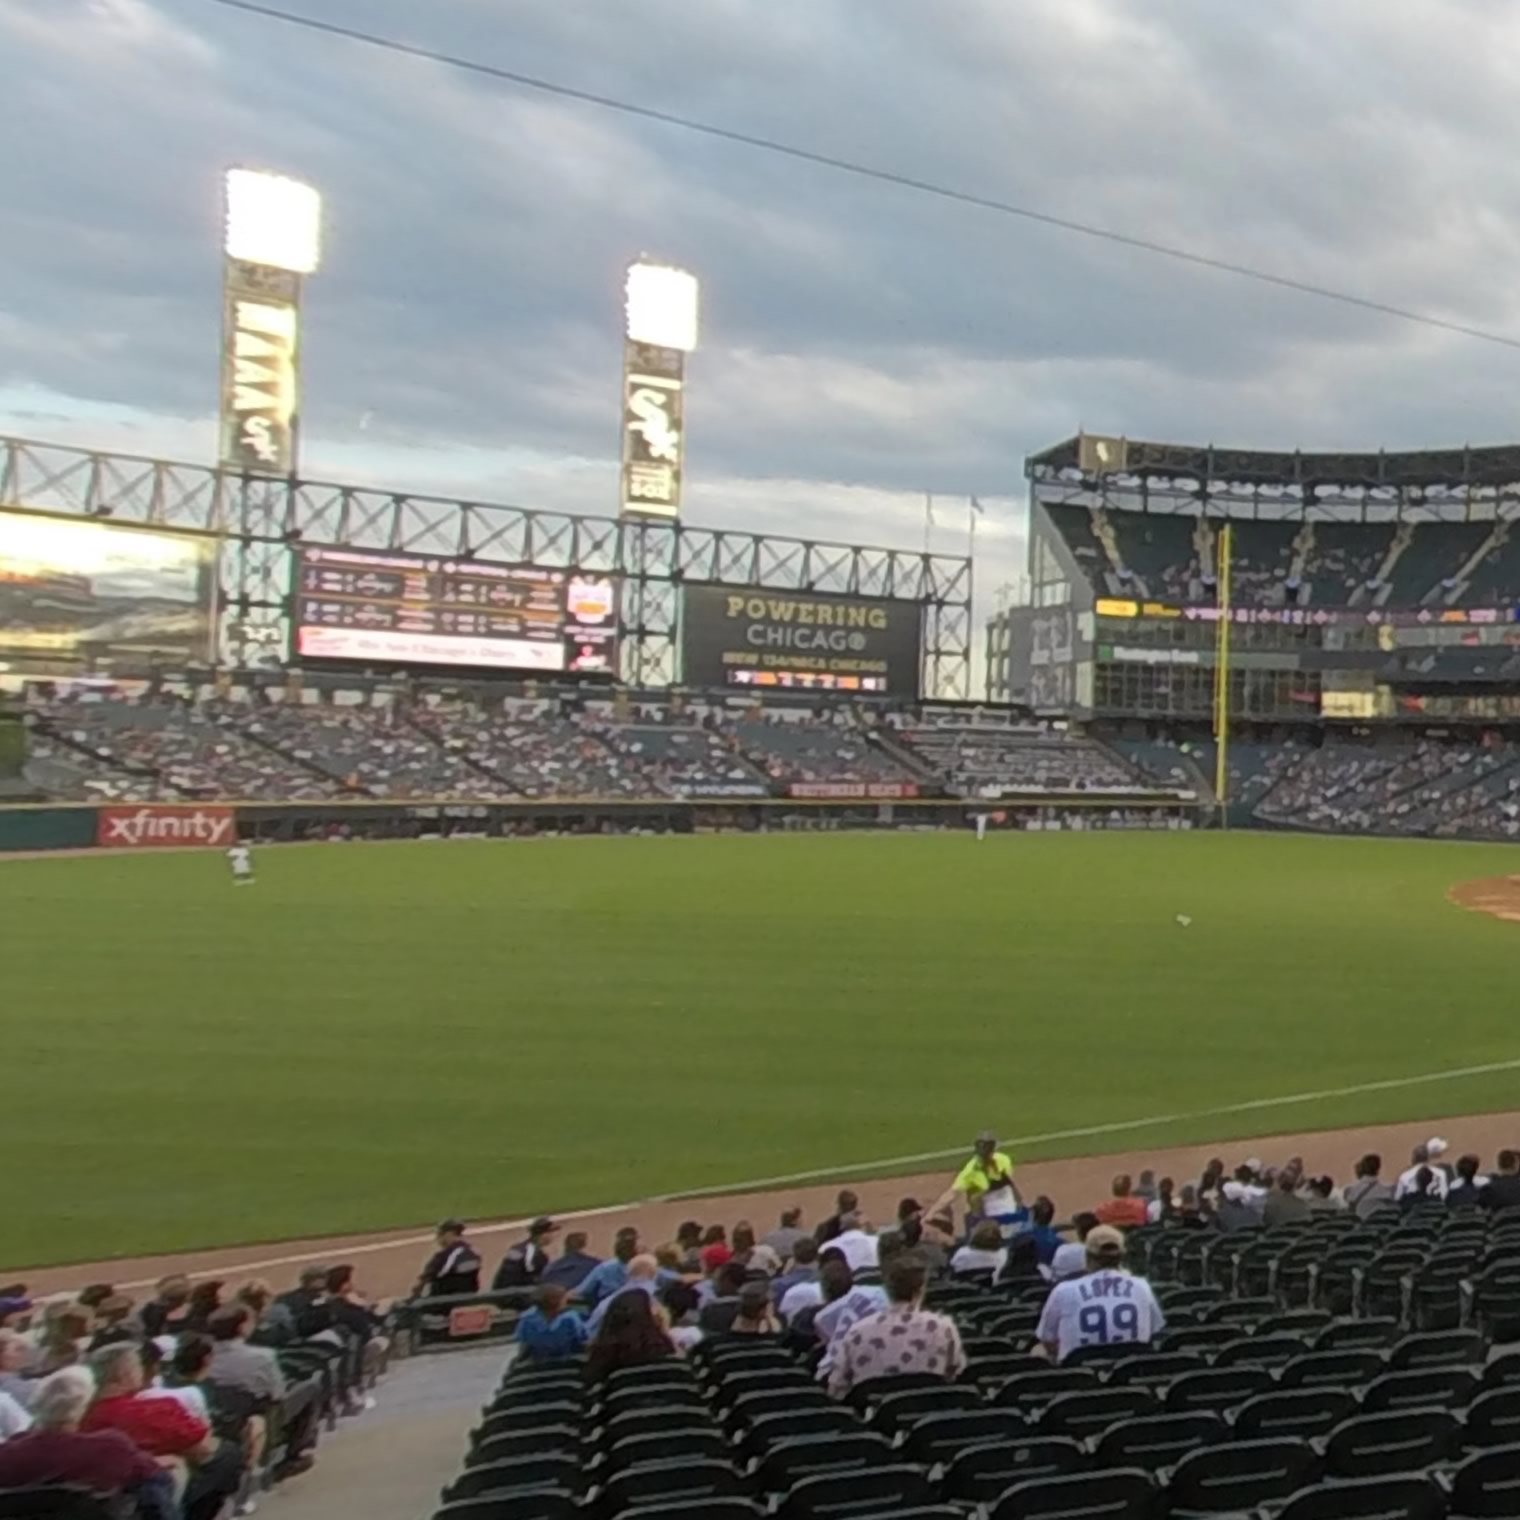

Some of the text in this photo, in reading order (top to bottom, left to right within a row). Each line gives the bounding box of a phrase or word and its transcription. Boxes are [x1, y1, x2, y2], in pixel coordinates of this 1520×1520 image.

[726, 595, 888, 629] POWERING
[108, 808, 232, 844] xfinity
[1079, 1277, 1134, 1301] LOPEZ
[1080, 1303, 1138, 1343] 99
